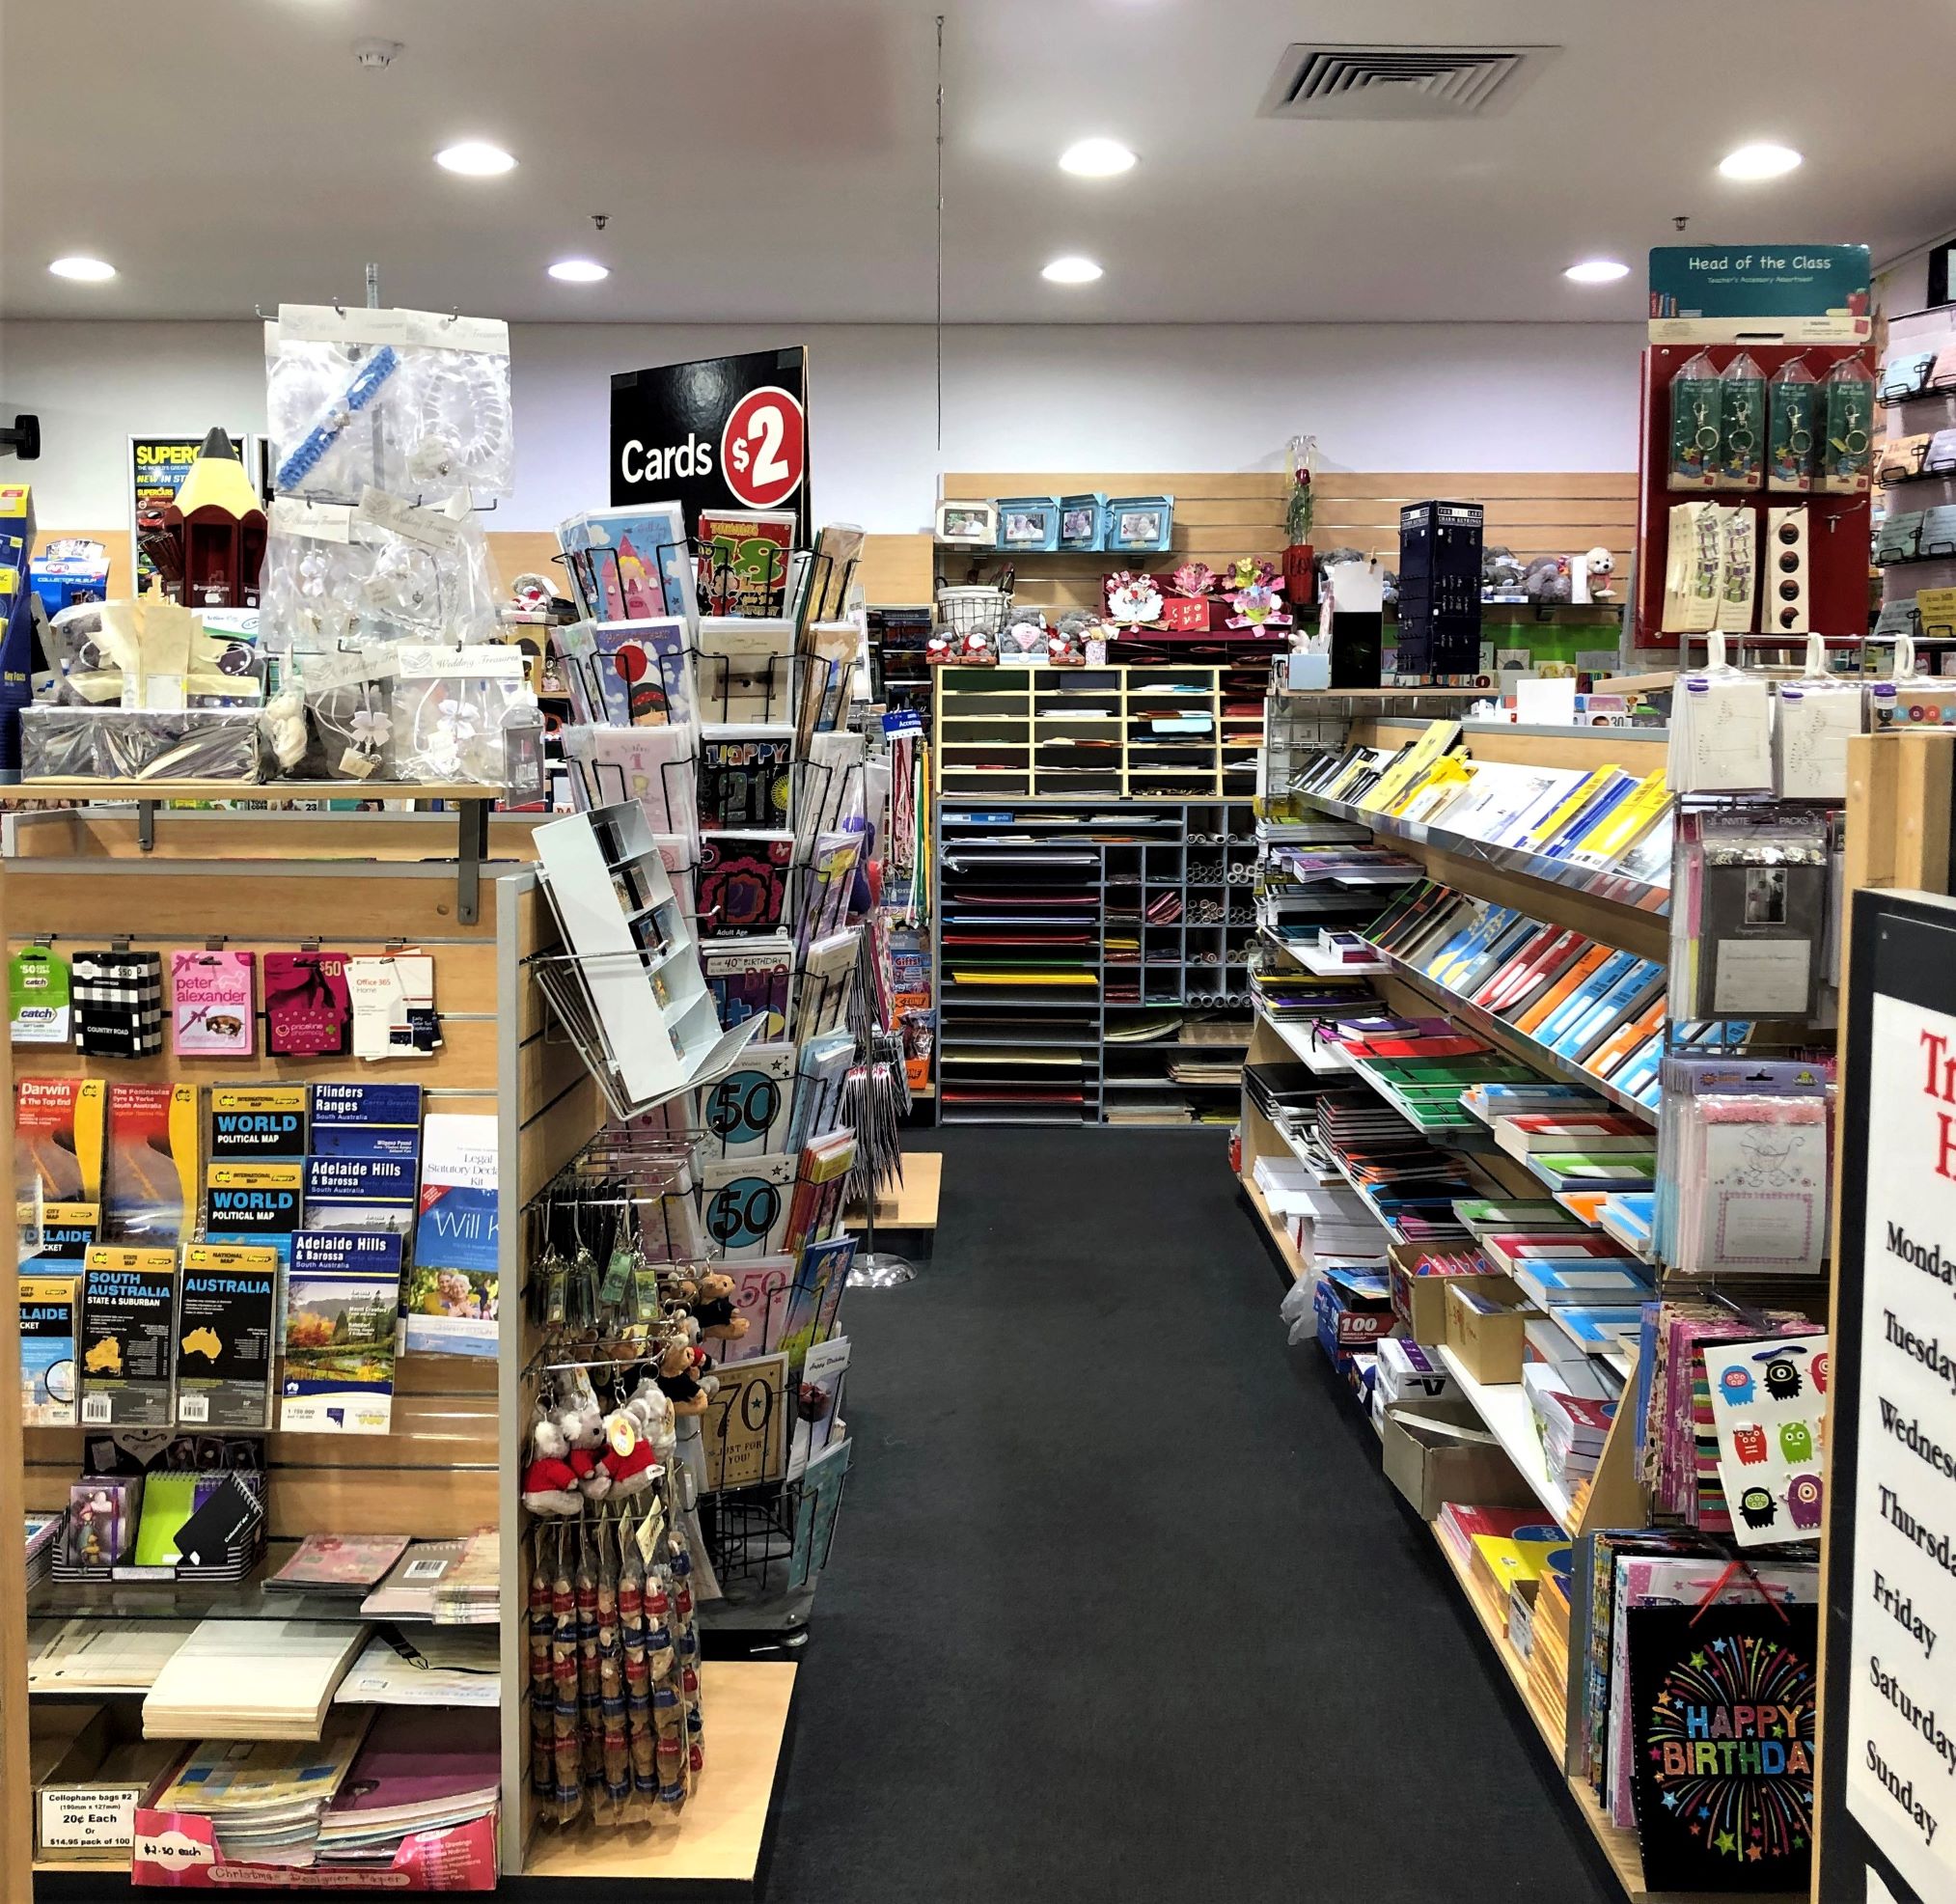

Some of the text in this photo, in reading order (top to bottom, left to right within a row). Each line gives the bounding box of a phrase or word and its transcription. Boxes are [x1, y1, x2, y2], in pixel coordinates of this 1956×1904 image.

[1690, 256, 1832, 270] Head of the Class
[621, 405, 789, 488] Cards $2
[137, 475, 158, 483] NEW
[160, 475, 171, 483] IN
[137, 488, 174, 497] SUPERCARS
[710, 522, 759, 537] TURNING
[436, 654, 520, 669] Wedding Treasures
[1611, 716, 1624, 727] 30
[706, 742, 788, 765] HAPPY
[743, 956, 784, 965] BIRTHDAY
[895, 956, 922, 966] Gifts!
[117, 967, 132, 977] $50
[319, 960, 342, 977] $50
[177, 977, 213, 992] peter
[177, 989, 247, 1004] alexander
[20, 1008, 52, 1019] catch
[87, 1026, 113, 1035] COUNTRY
[290, 1029, 324, 1037] pharmacy
[22, 1083, 70, 1096] Darwin
[316, 1085, 364, 1098] Flinders
[42, 1098, 56, 1107] Top
[316, 1099, 358, 1114] Ranges
[712, 1082, 777, 1134] 50
[217, 1115, 298, 1132] WORLD
[217, 1135, 280, 1144] POLITICAL MAP
[463, 1153, 493, 1166] Legal
[311, 1161, 401, 1176] Adelaide Hills
[427, 1163, 471, 1176] Statutory
[311, 1175, 359, 1186] & Barossa
[470, 1176, 483, 1186] Kit
[213, 1192, 293, 1209] WORLD
[212, 1211, 275, 1220] POLITICAL MAP
[712, 1187, 777, 1239] 50
[436, 1211, 481, 1240] Will
[295, 1236, 387, 1252] Adelaide Hills
[295, 1251, 344, 1260] & Barossa
[89, 1273, 141, 1284] SOUTH
[87, 1284, 170, 1298] AUSTRALIA
[185, 1279, 271, 1294] AUSTRALIA
[736, 1270, 786, 1309] 50
[87, 1296, 110, 1305] STATE
[118, 1297, 160, 1307] SUBURBAN
[1341, 1317, 1377, 1332] 100
[809, 1355, 845, 1371] Happy Birthday
[716, 1378, 772, 1438] 70
[717, 1440, 762, 1457] JUST FOR
[727, 1452, 751, 1464] YOU!
[1873, 1568, 1937, 1660] Friday
[1687, 1704, 1804, 1738] HAPPY
[1866, 1739, 1938, 1846] Sunday
[63, 1813, 117, 1824] 20¢ Each
[80, 1837, 101, 1846] pack
[178, 1846, 202, 1857] each
[358, 1874, 401, 1885] Paper
